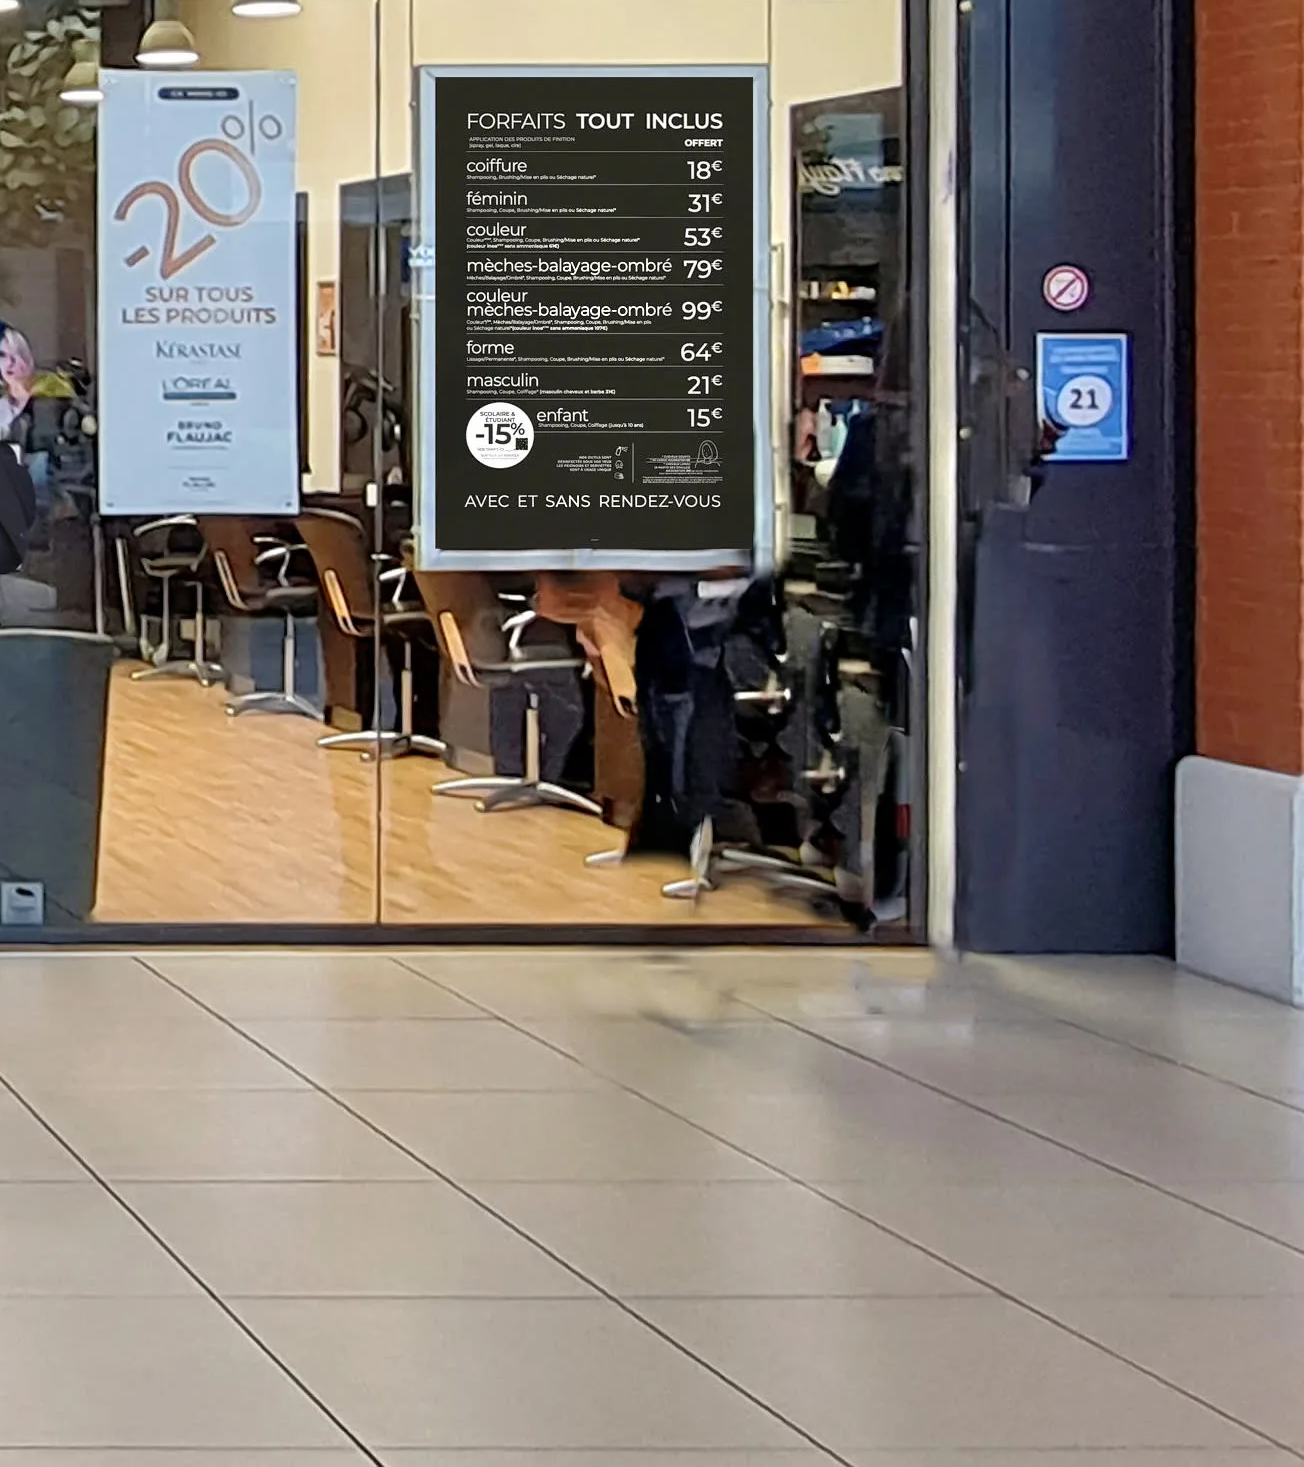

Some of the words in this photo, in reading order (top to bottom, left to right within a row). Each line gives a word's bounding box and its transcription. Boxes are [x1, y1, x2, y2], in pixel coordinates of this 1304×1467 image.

[468, 113, 565, 129] FORFAITS
[576, 113, 635, 129] TOUT
[646, 113, 723, 129] INCLUS
[684, 139, 723, 147] OFFERT
[467, 158, 527, 172] coiffure
[687, 160, 722, 179] 18€
[466, 191, 527, 205] féminin
[688, 193, 722, 212] 31€
[467, 222, 527, 236] couleur
[684, 227, 722, 246] 53€
[467, 258, 672, 276] mèches-balayage-ombré
[683, 259, 722, 278] 79€
[145, 286, 189, 302] SUR
[195, 286, 254, 302] TOUS
[467, 288, 528, 302] couleur
[121, 308, 160, 324] LES
[166, 307, 277, 324] PRODUITS
[467, 302, 672, 319] mèches-balayage-ombré
[682, 301, 722, 320] 99€
[466, 340, 514, 354] forme
[681, 342, 722, 361] 64€
[467, 373, 539, 387] masculin
[687, 375, 722, 394] 21€
[1068, 388, 1100, 410] 21
[537, 408, 589, 421] enfant
[687, 408, 722, 427] 15€
[178, 421, 222, 430] BRUNO
[167, 431, 232, 443] FLAUJAC
[475, 423, 525, 445] -15%
[464, 495, 509, 507] AVEC
[518, 495, 538, 507] ET
[546, 495, 590, 507] SANS
[600, 495, 721, 507] RENDEZ-VOUS
